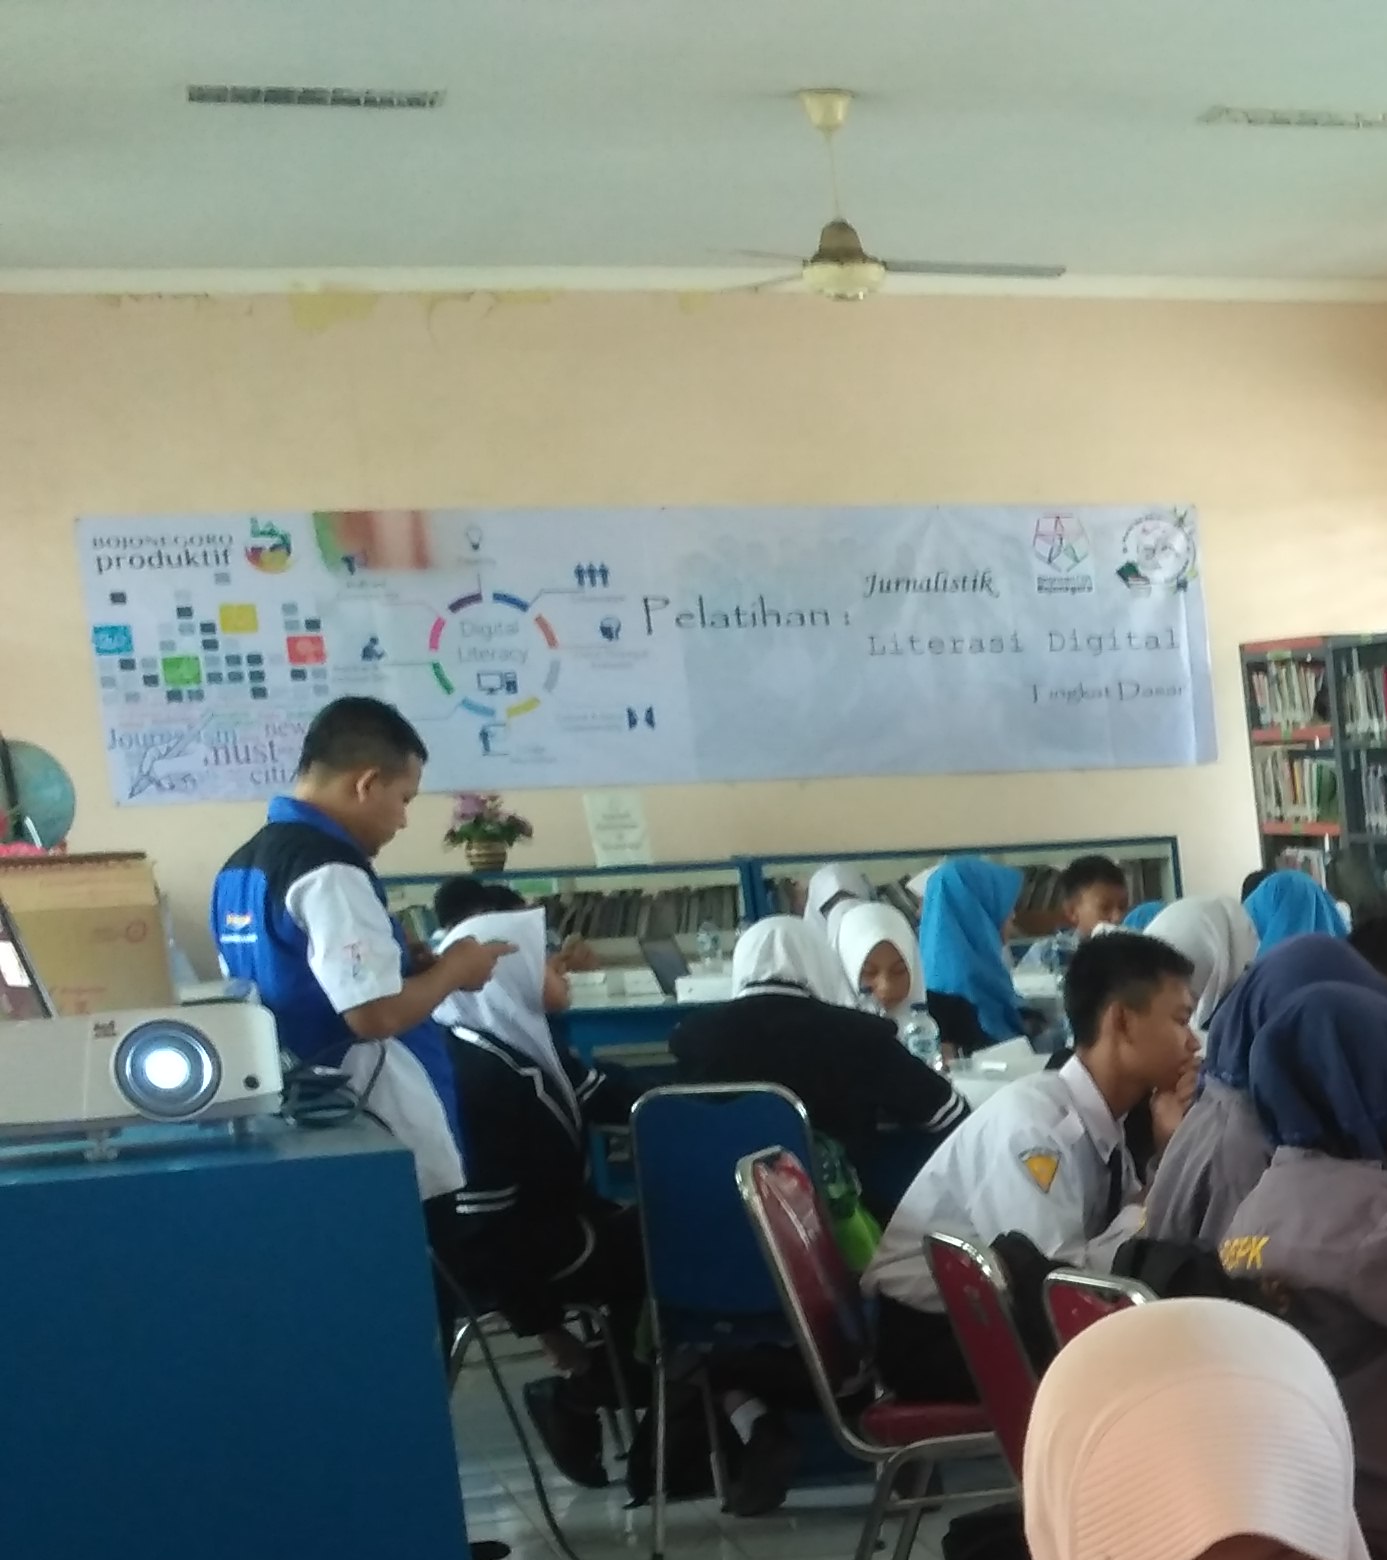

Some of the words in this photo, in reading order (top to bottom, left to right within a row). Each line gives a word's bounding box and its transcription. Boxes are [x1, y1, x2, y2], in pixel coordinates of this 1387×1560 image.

[95, 548, 231, 575] produktif
[862, 570, 1001, 600] Jurnalistik
[459, 619, 520, 642] Digital
[867, 632, 1026, 657] Literasi
[1047, 625, 1181, 659] Digital
